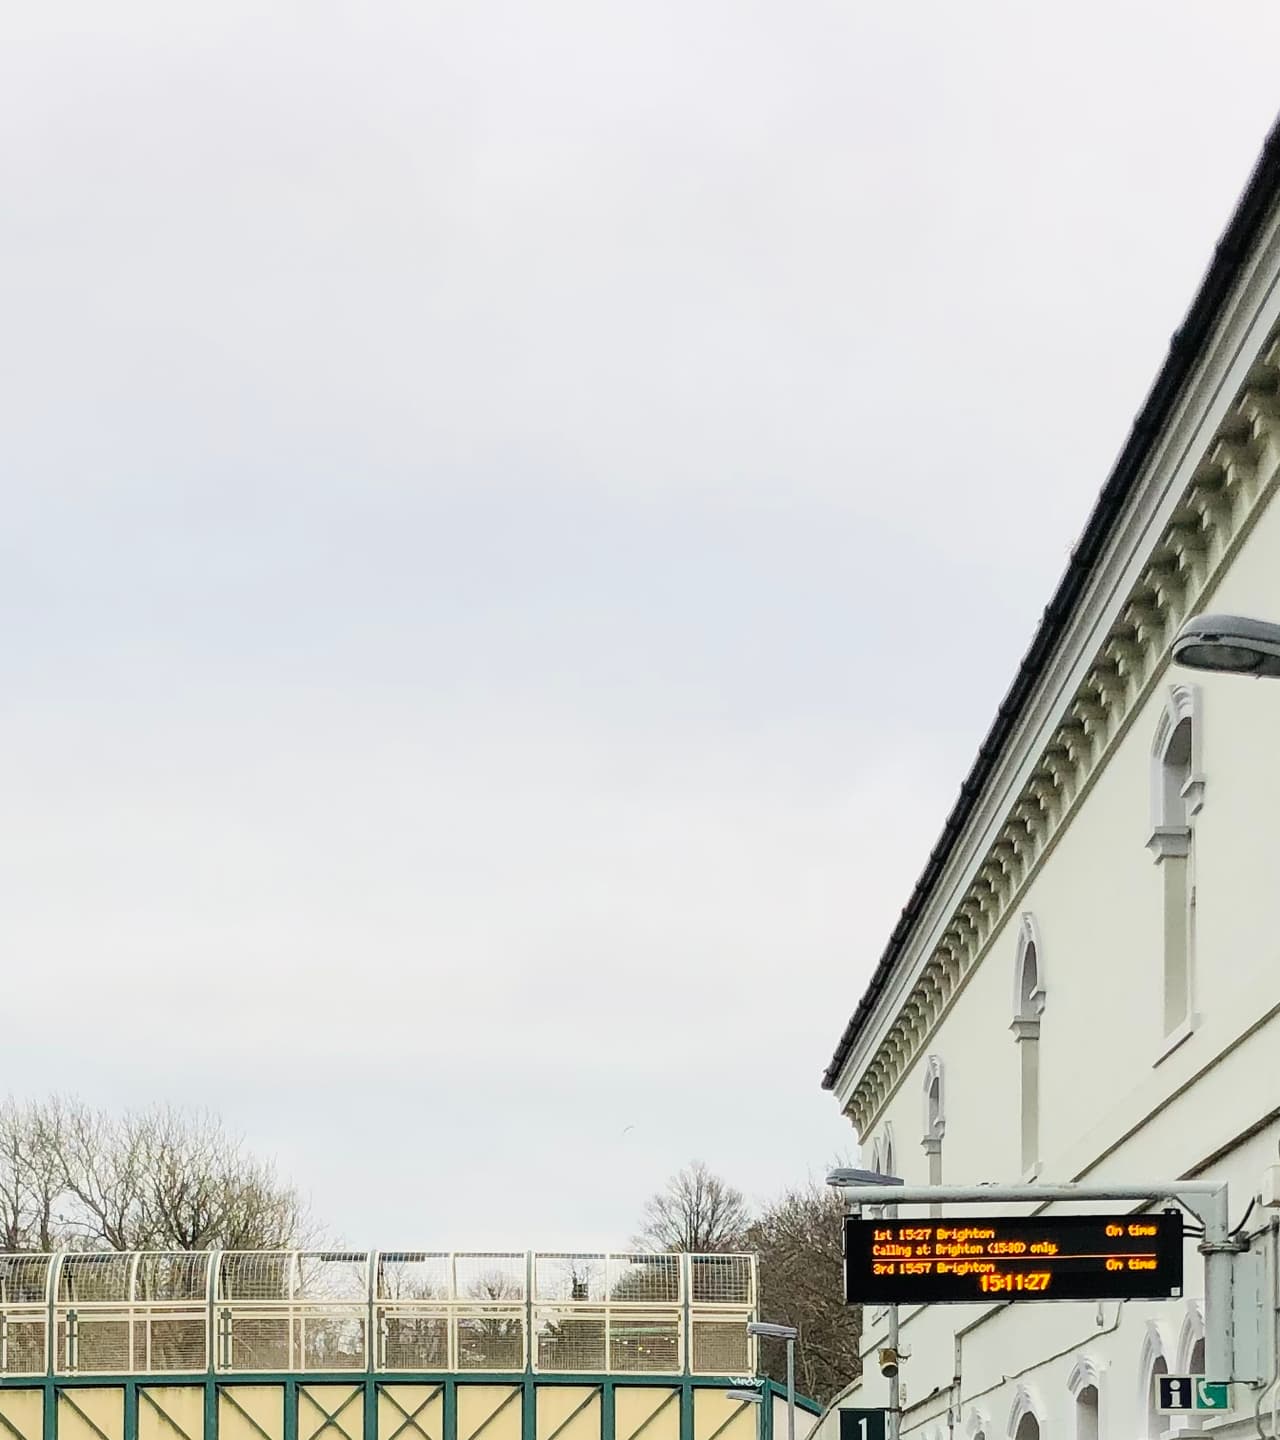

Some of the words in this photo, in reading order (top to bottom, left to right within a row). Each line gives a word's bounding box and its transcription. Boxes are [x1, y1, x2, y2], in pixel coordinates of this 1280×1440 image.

[874, 1229, 893, 1241] 1st
[899, 1228, 932, 1241] 15:27
[936, 1227, 995, 1243] Brighton
[1105, 1224, 1123, 1237] On
[1127, 1224, 1157, 1236] time
[872, 1244, 912, 1258] Calling
[935, 1242, 984, 1257] Brighton
[873, 1263, 895, 1275] 3rd
[899, 1262, 932, 1275] 15:57
[936, 1261, 996, 1276] Brighton
[1105, 1258, 1123, 1271] On
[1127, 1258, 1157, 1270] time
[981, 1272, 1051, 1292] 15:11:27
